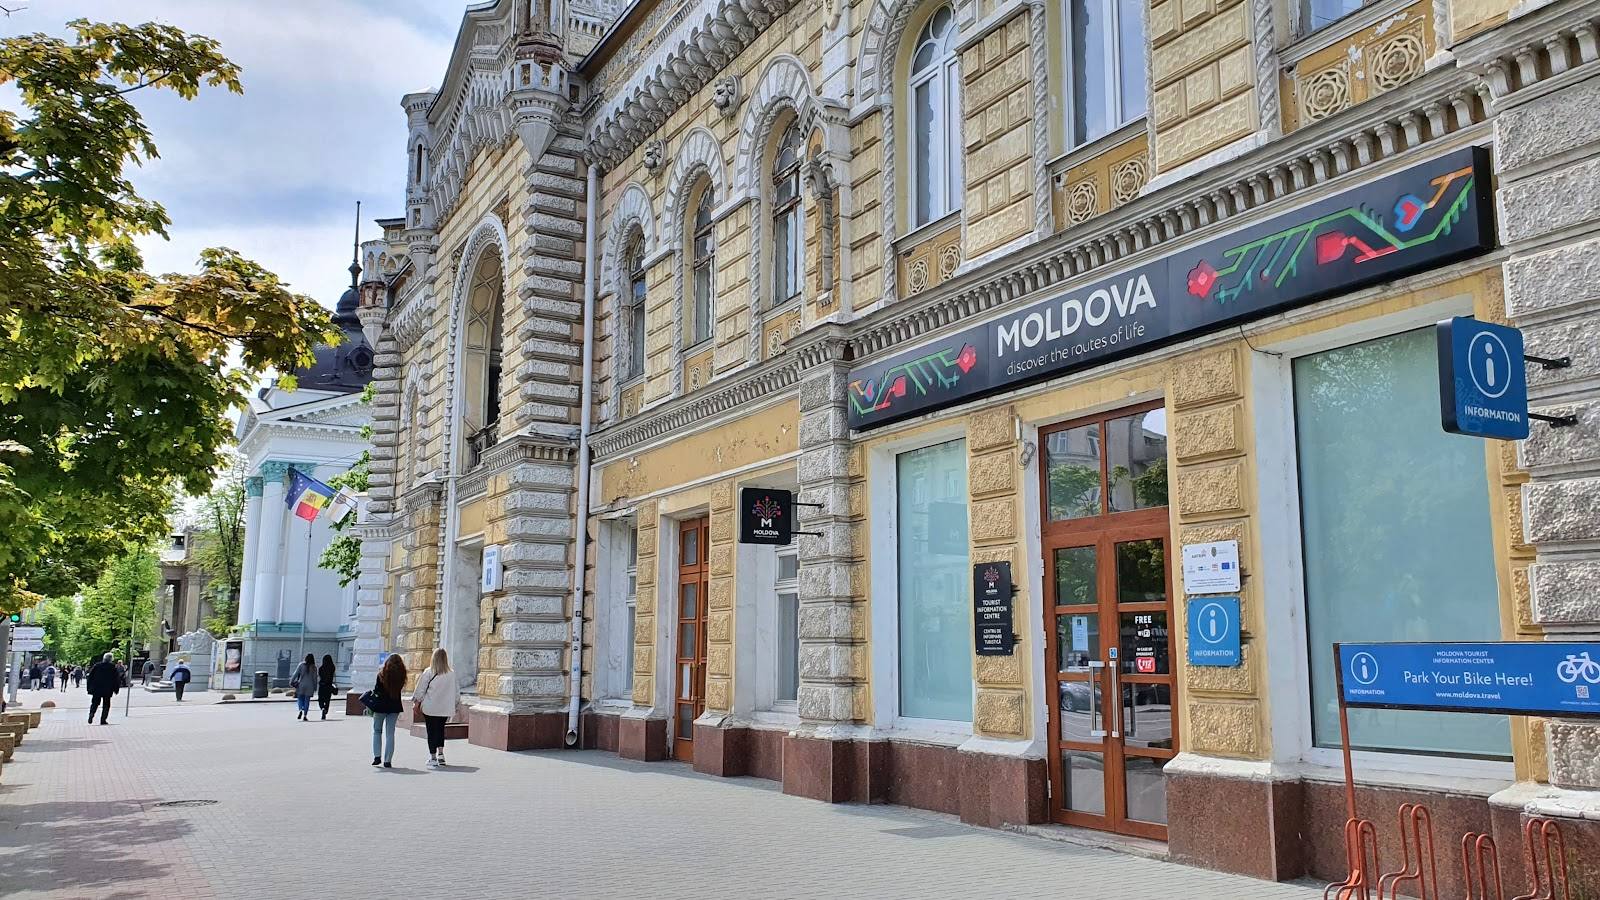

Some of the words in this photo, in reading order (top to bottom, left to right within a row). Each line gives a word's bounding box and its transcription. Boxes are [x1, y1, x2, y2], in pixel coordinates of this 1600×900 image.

[997, 274, 1156, 357] MOLDOVA
[1007, 355, 1048, 375] discover
[1050, 347, 1068, 362] the
[1071, 336, 1107, 357] routes
[1109, 326, 1123, 345] of
[1125, 321, 1145, 341] life
[1464, 405, 1520, 423] INFORMATION
[761, 518, 772, 528] M
[1194, 649, 1234, 657] INFORMATION
[1404, 671, 1429, 684] Park
[1432, 671, 1460, 684] Your
[1463, 671, 1491, 685] Bike
[1495, 672, 1533, 686] Here!
